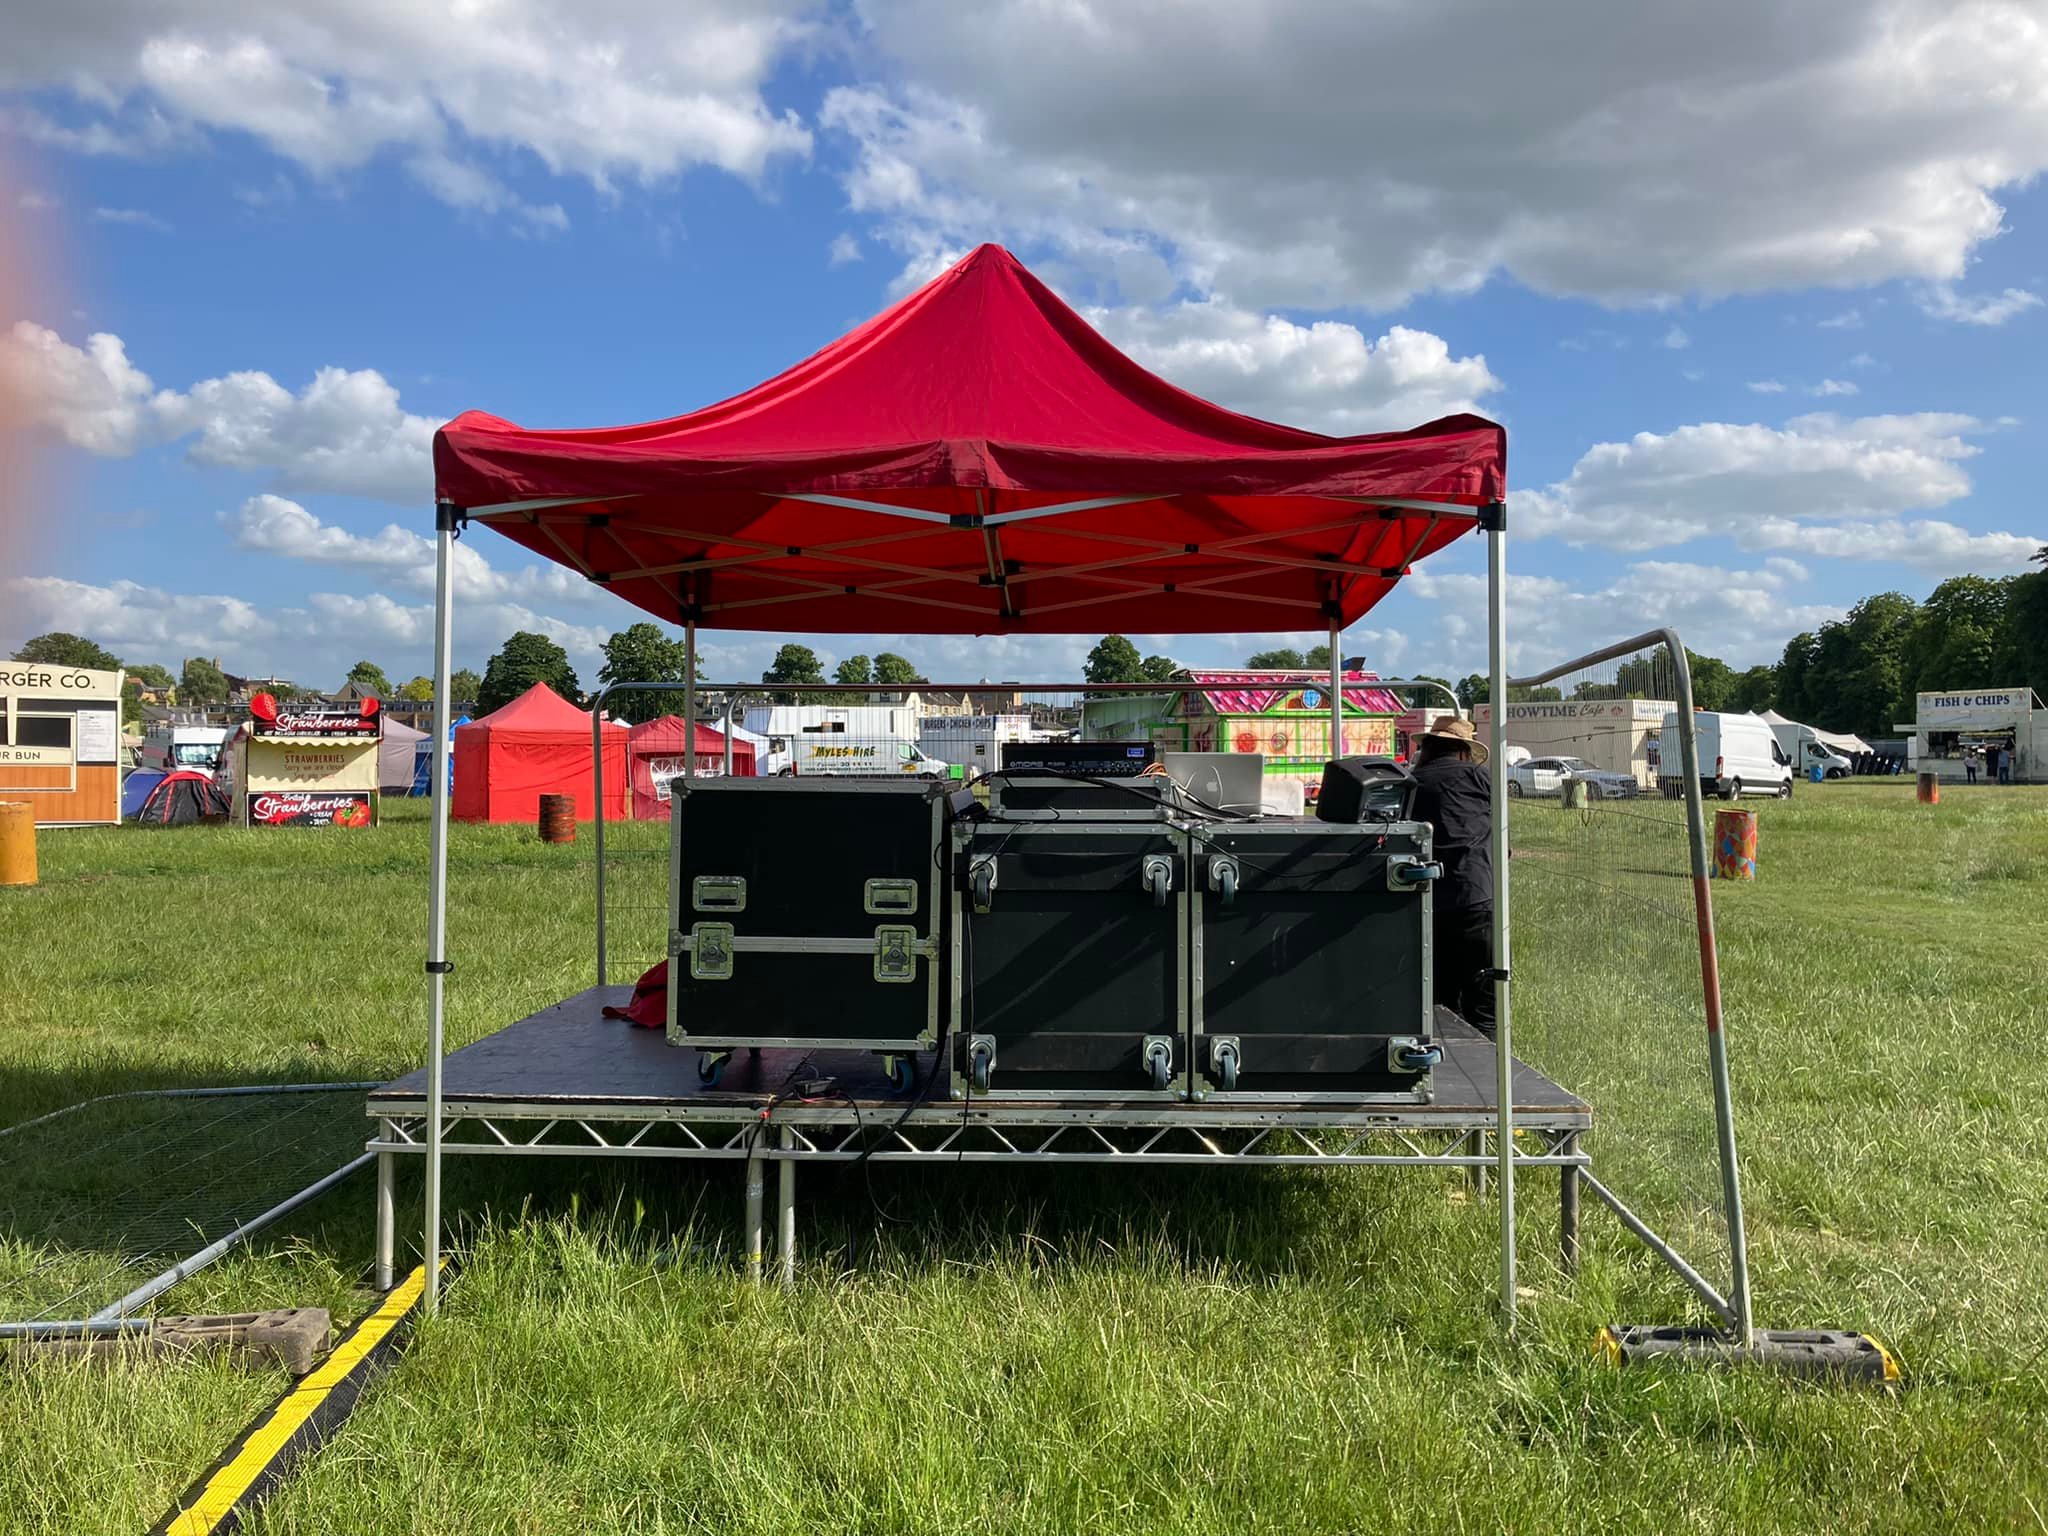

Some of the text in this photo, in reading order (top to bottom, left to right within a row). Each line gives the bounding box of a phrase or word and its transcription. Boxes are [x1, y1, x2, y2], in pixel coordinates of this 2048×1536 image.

[60, 674, 96, 689] CO.
[1934, 695, 2010, 707] FISH & CHIPS
[1507, 704, 1577, 718] HOWTIME
[275, 713, 359, 730] Strawberries
[15, 752, 41, 760] BUN
[816, 746, 876, 757] MYLES HIRE
[285, 754, 345, 763] STRAWBERRIES
[254, 795, 353, 819] Strawberries
